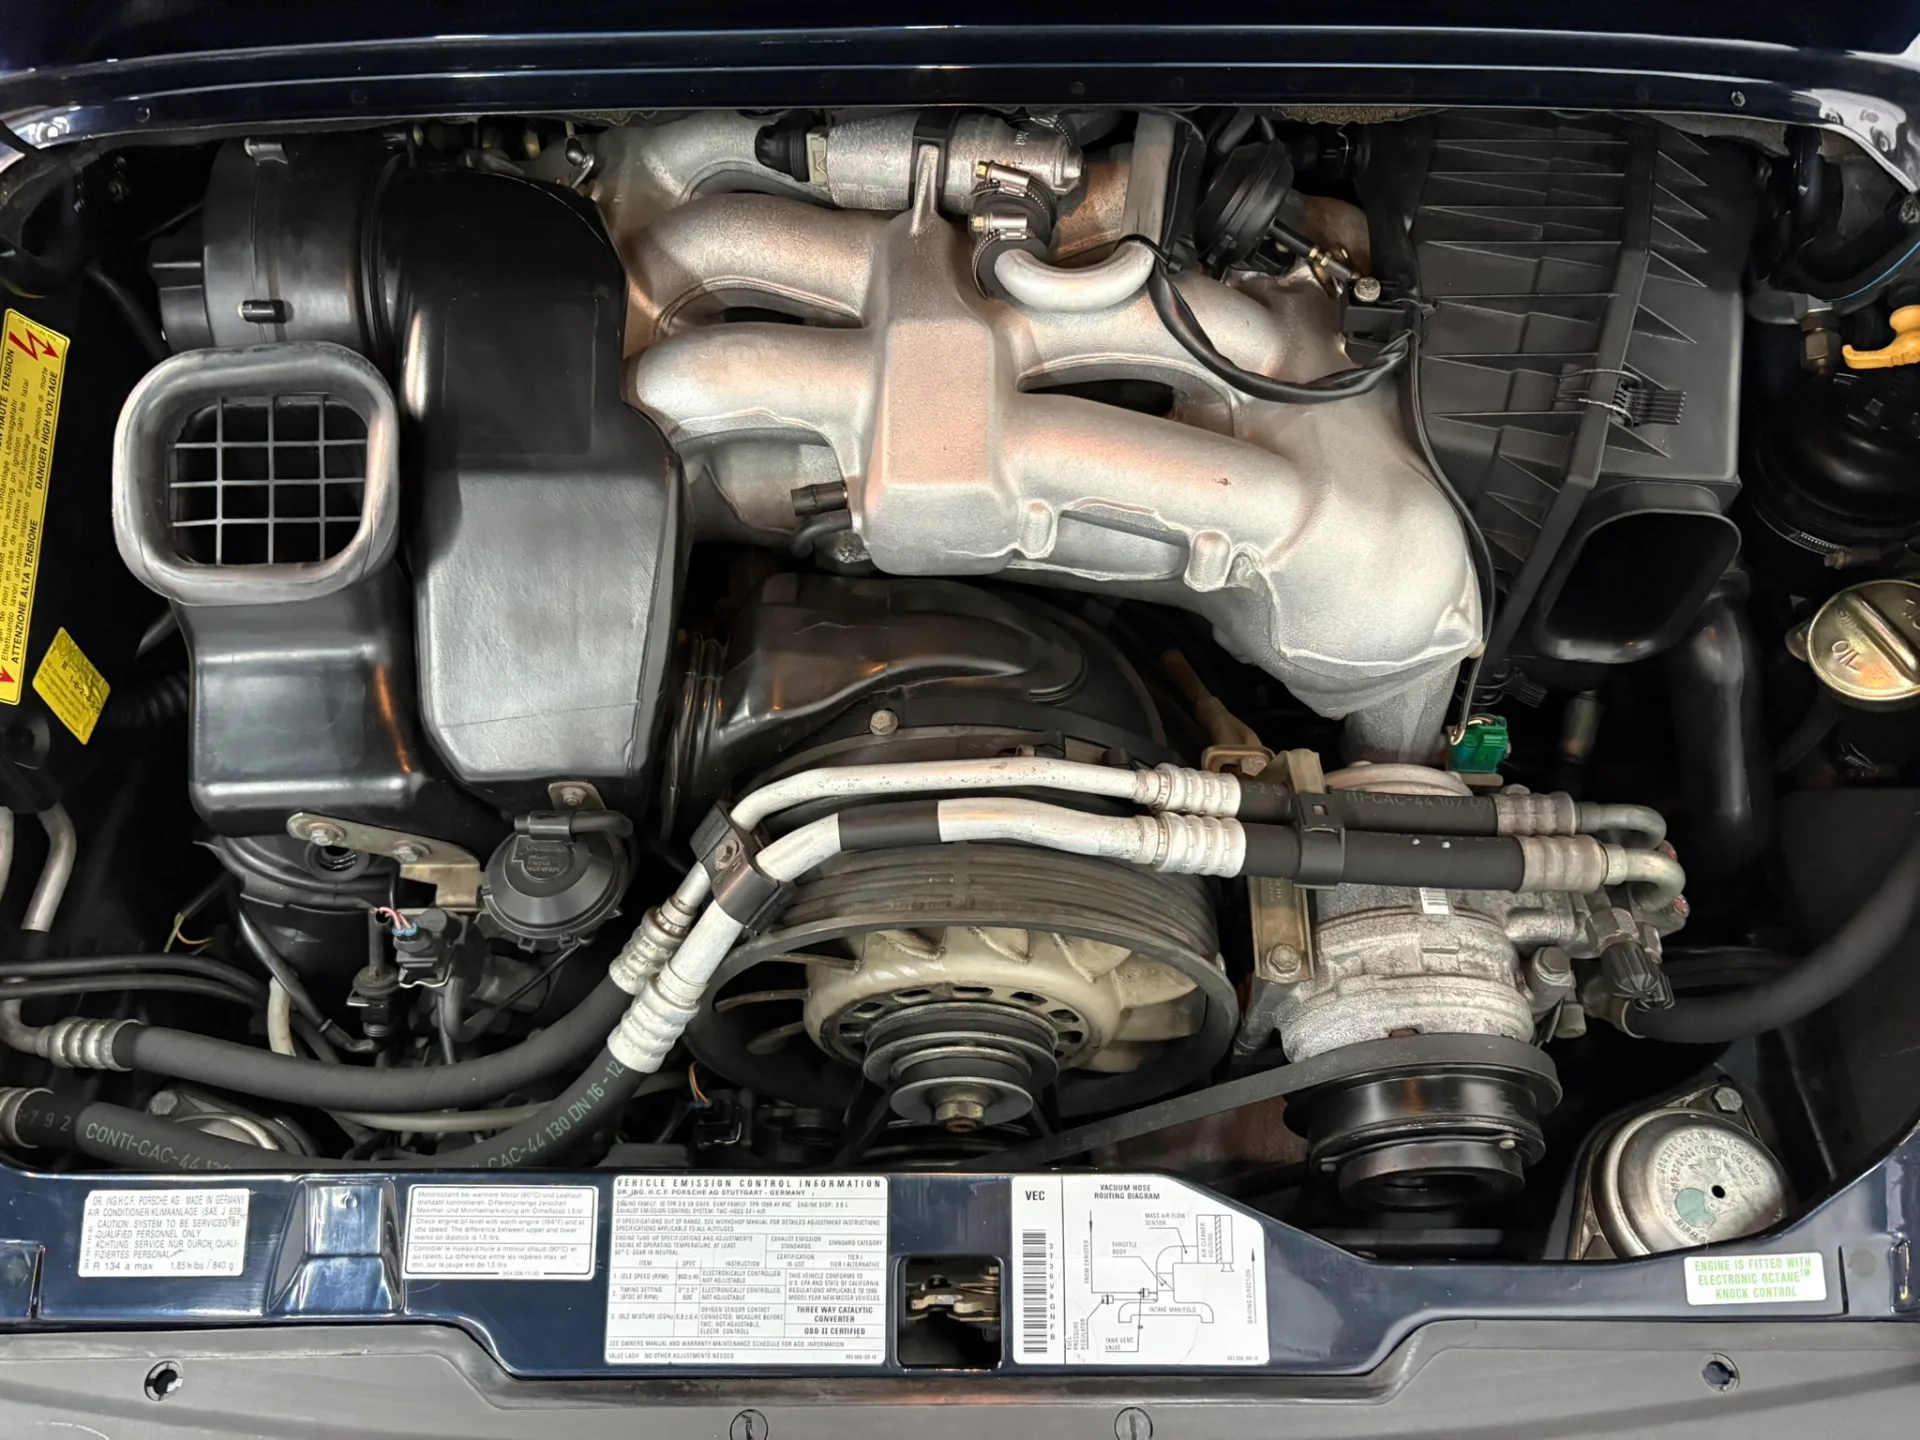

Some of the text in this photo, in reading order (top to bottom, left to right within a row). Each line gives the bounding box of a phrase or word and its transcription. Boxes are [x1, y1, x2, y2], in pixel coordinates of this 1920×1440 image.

[1, 348, 15, 393] TENSION
[40, 366, 48, 391] morte
[21, 378, 29, 398] fatal
[38, 393, 44, 402] di
[19, 401, 26, 413] be
[4, 398, 18, 456] Lebensgefahr
[34, 406, 43, 440] pericolo
[35, 371, 58, 490] DANGER HIGH VOLTAGE
[11, 437, 21, 467] ignition
[10, 472, 17, 483] on
[5, 488, 15, 520] working
[12, 499, 21, 529] travaux
[20, 502, 30, 537] impianto
[10, 534, 16, 545] de
[5, 570, 11, 581] en
[9, 583, 18, 606] lavori
[11, 519, 38, 664] ATTENZIONE ALTA TENSIONE
[1831, 639, 1860, 672] OIL
[545, 1115, 571, 1141] 130
[567, 1097, 592, 1122] DN
[587, 1083, 605, 1101] 16
[617, 1178, 881, 1188] VEHICLE EMISSION CONTROL INFORMATION
[1100, 1184, 1151, 1192] VACUUM HOSE
[1025, 1190, 1045, 1201] VEC
[1094, 1192, 1160, 1200] ROUTING DIAGRAM
[87, 1208, 100, 1217] AIR
[103, 1208, 150, 1217] CONDITIONER
[150, 1207, 199, 1216] KLIMAANLAGE
[133, 1219, 162, 1228] SYSTEM
[166, 1219, 176, 1228] TO
[179, 1219, 189, 1228] BE
[192, 1218, 227, 1228] SERVICED
[231, 1218, 241, 1227] BY
[95, 1229, 201, 1239] QUALIFIED PERSONNEL ONLY
[134, 1240, 165, 1249] SERVICE
[168, 1239, 184, 1248] NUR
[187, 1239, 212, 1249] DURCH
[94, 1250, 170, 1259] FIZIERTES PERSONAL
[93, 1262, 100, 1270] R
[105, 1262, 121, 1270] 134
[212, 1261, 226, 1270] 840
[1695, 1257, 1811, 1272] ENGINE IS FITTED WITH
[1698, 1273, 1758, 1286] ELECTRONIC
[1715, 1286, 1797, 1300] KNOCK CONTROL
[796, 1306, 873, 1314] THREE WAY CATALYTIC
[814, 1315, 855, 1323] CONVERTER
[804, 1327, 866, 1335] OBD II CERTIFIED
